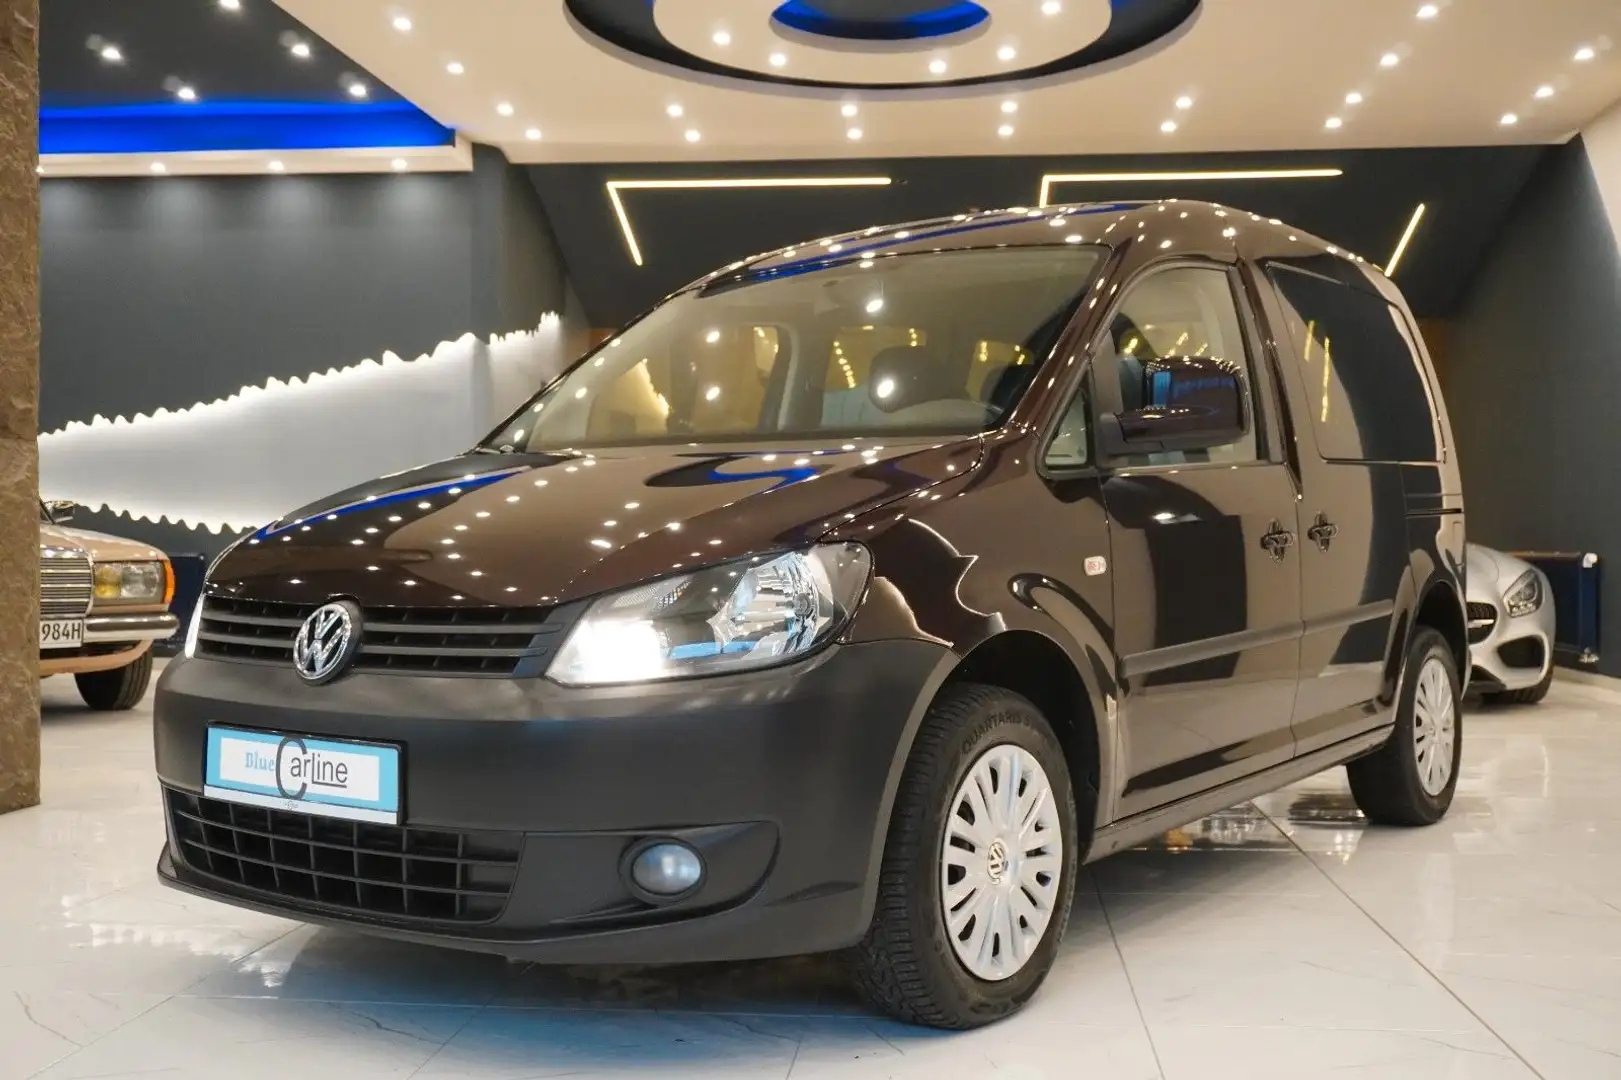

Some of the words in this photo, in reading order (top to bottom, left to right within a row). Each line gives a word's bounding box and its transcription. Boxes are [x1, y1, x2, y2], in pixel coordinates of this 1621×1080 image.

[42, 622, 81, 642] 984H
[293, 603, 352, 680] VW
[244, 750, 277, 773] Blue
